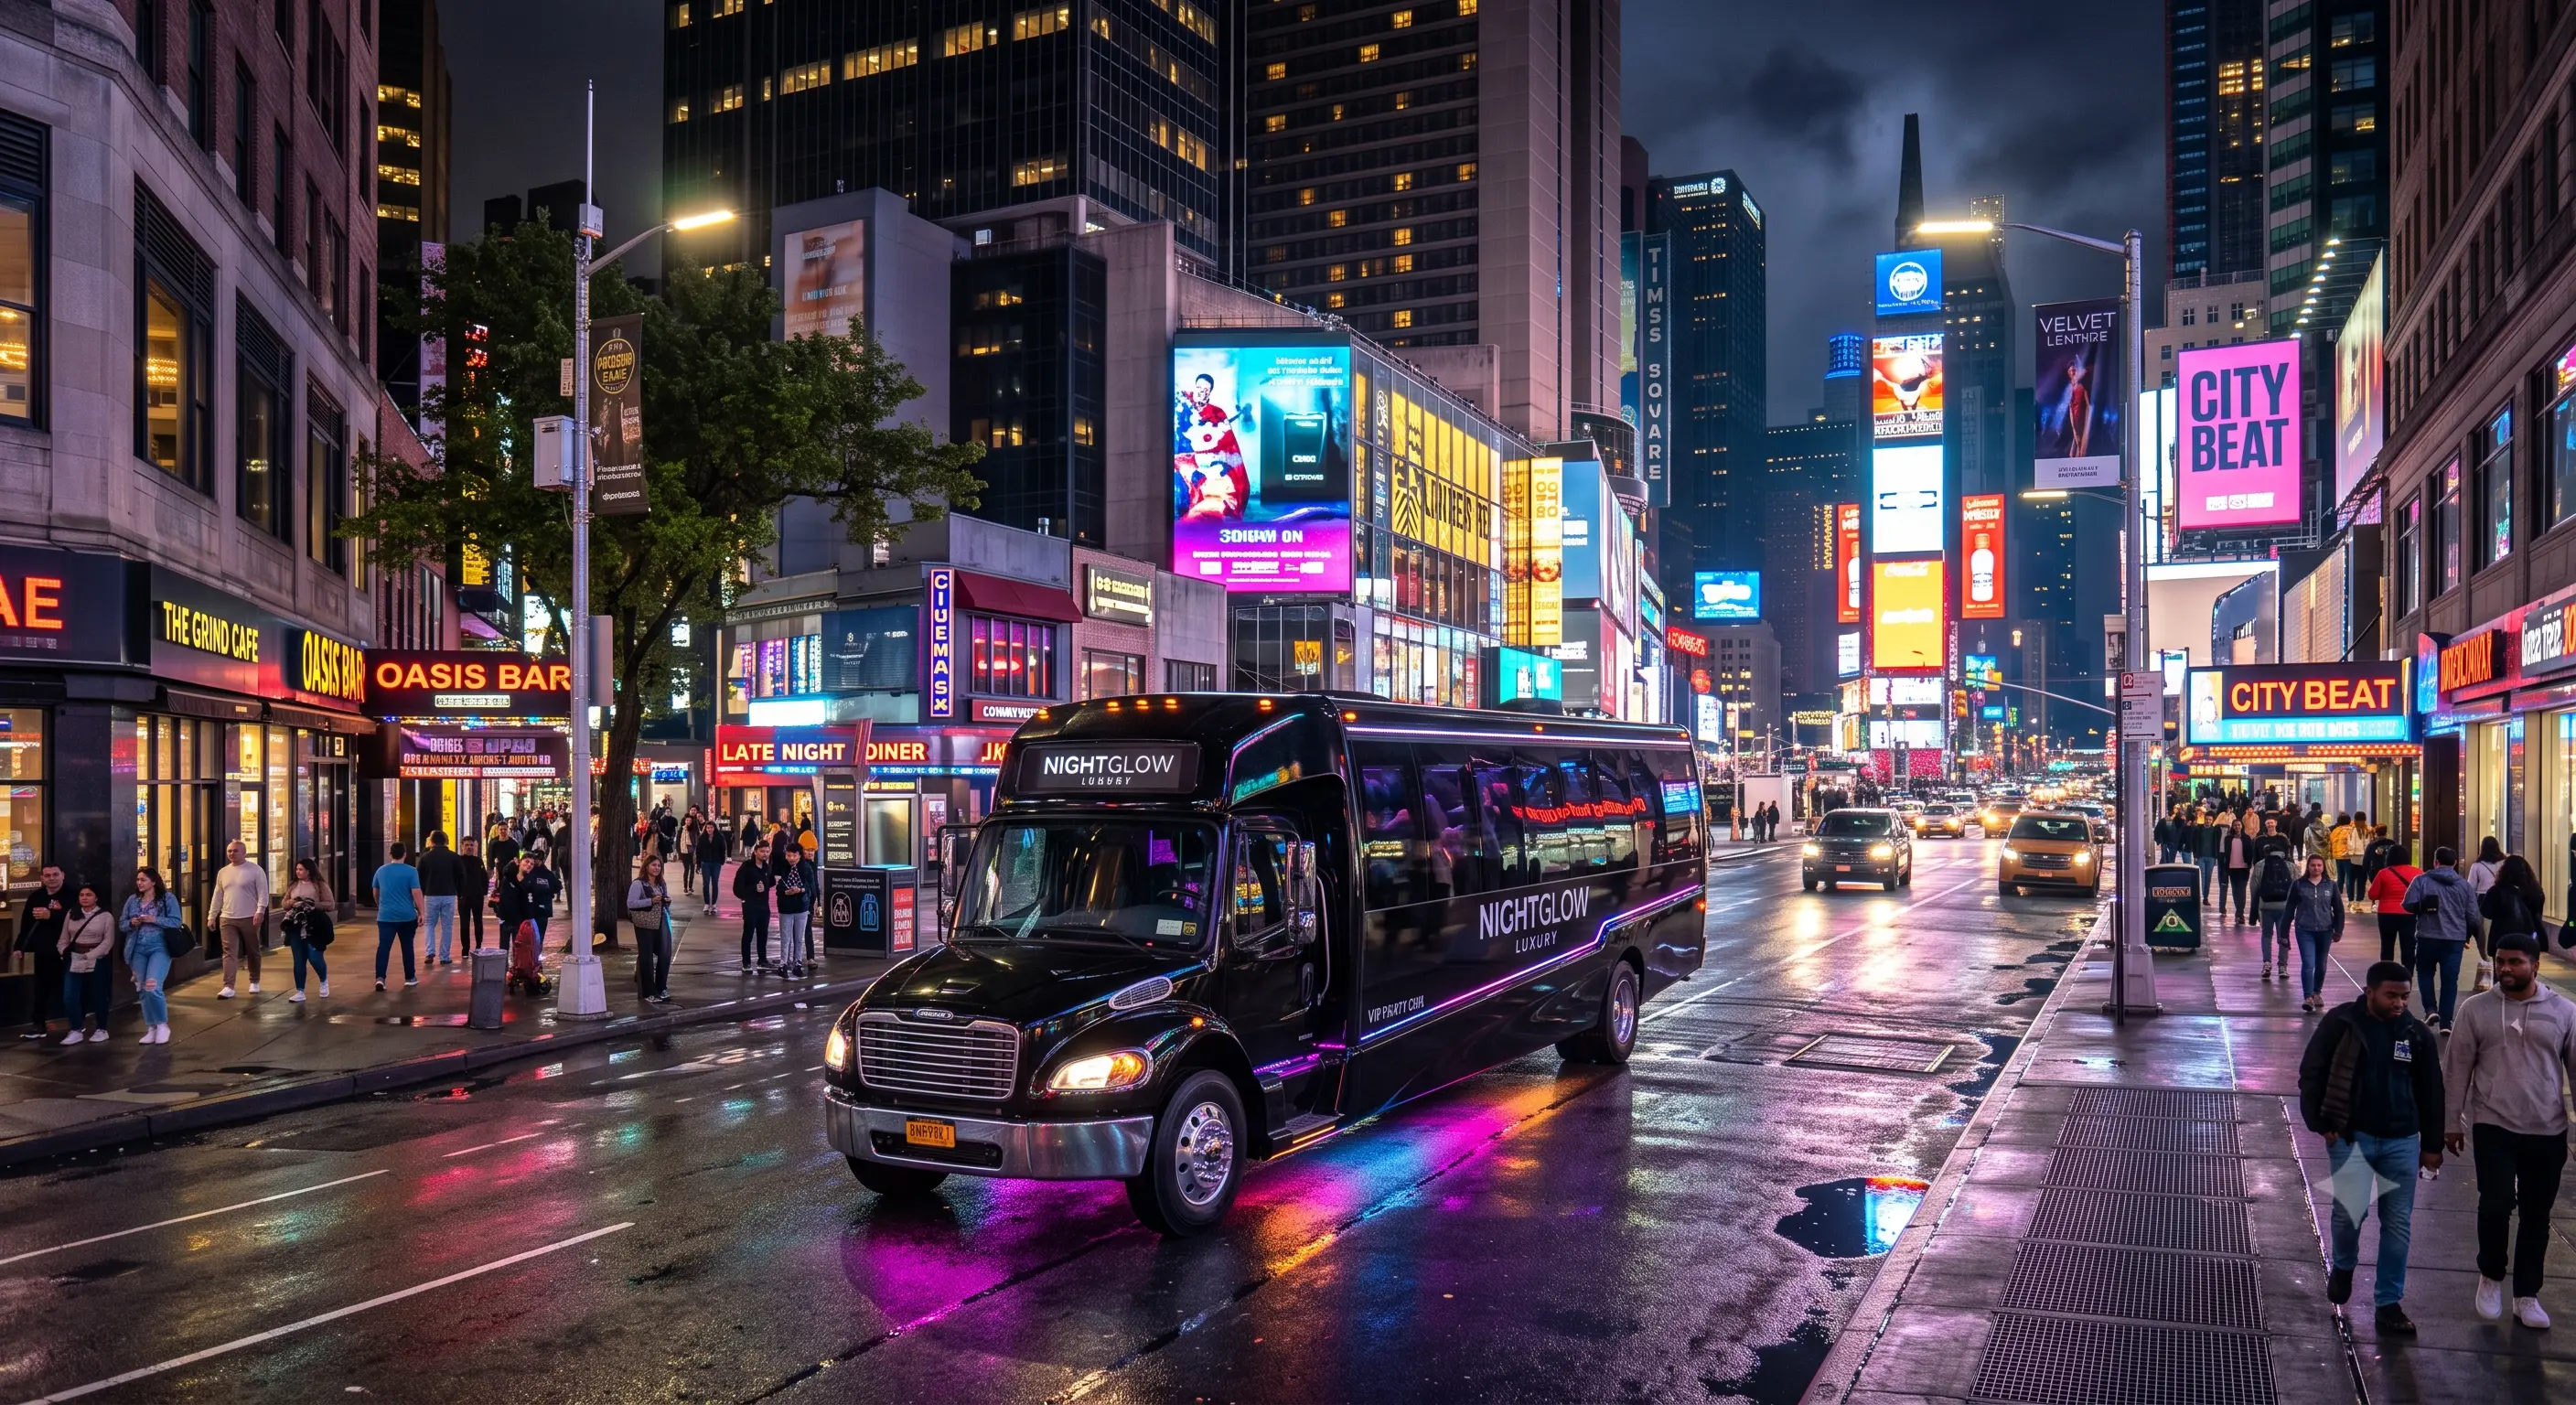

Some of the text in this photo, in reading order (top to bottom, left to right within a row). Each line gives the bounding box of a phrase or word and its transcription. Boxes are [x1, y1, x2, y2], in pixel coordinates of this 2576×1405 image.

[2039, 311, 2117, 334] VELVET
[2191, 362, 2290, 423] CITY
[2191, 418, 2290, 473] BEAT
[163, 600, 259, 663] THE GRIND CAFE
[303, 630, 340, 697] OASIS
[376, 662, 572, 691] OASIS BAR
[2230, 678, 2396, 713] CITY BEAT
[723, 743, 775, 761] LATE
[782, 743, 846, 761] NIGHT
[866, 743, 926, 761] DINER
[1044, 755, 1175, 775] NIGHTGLOW
[1479, 885, 1590, 940] NIGHTGLOW
[1515, 930, 1558, 954] LUXURY
